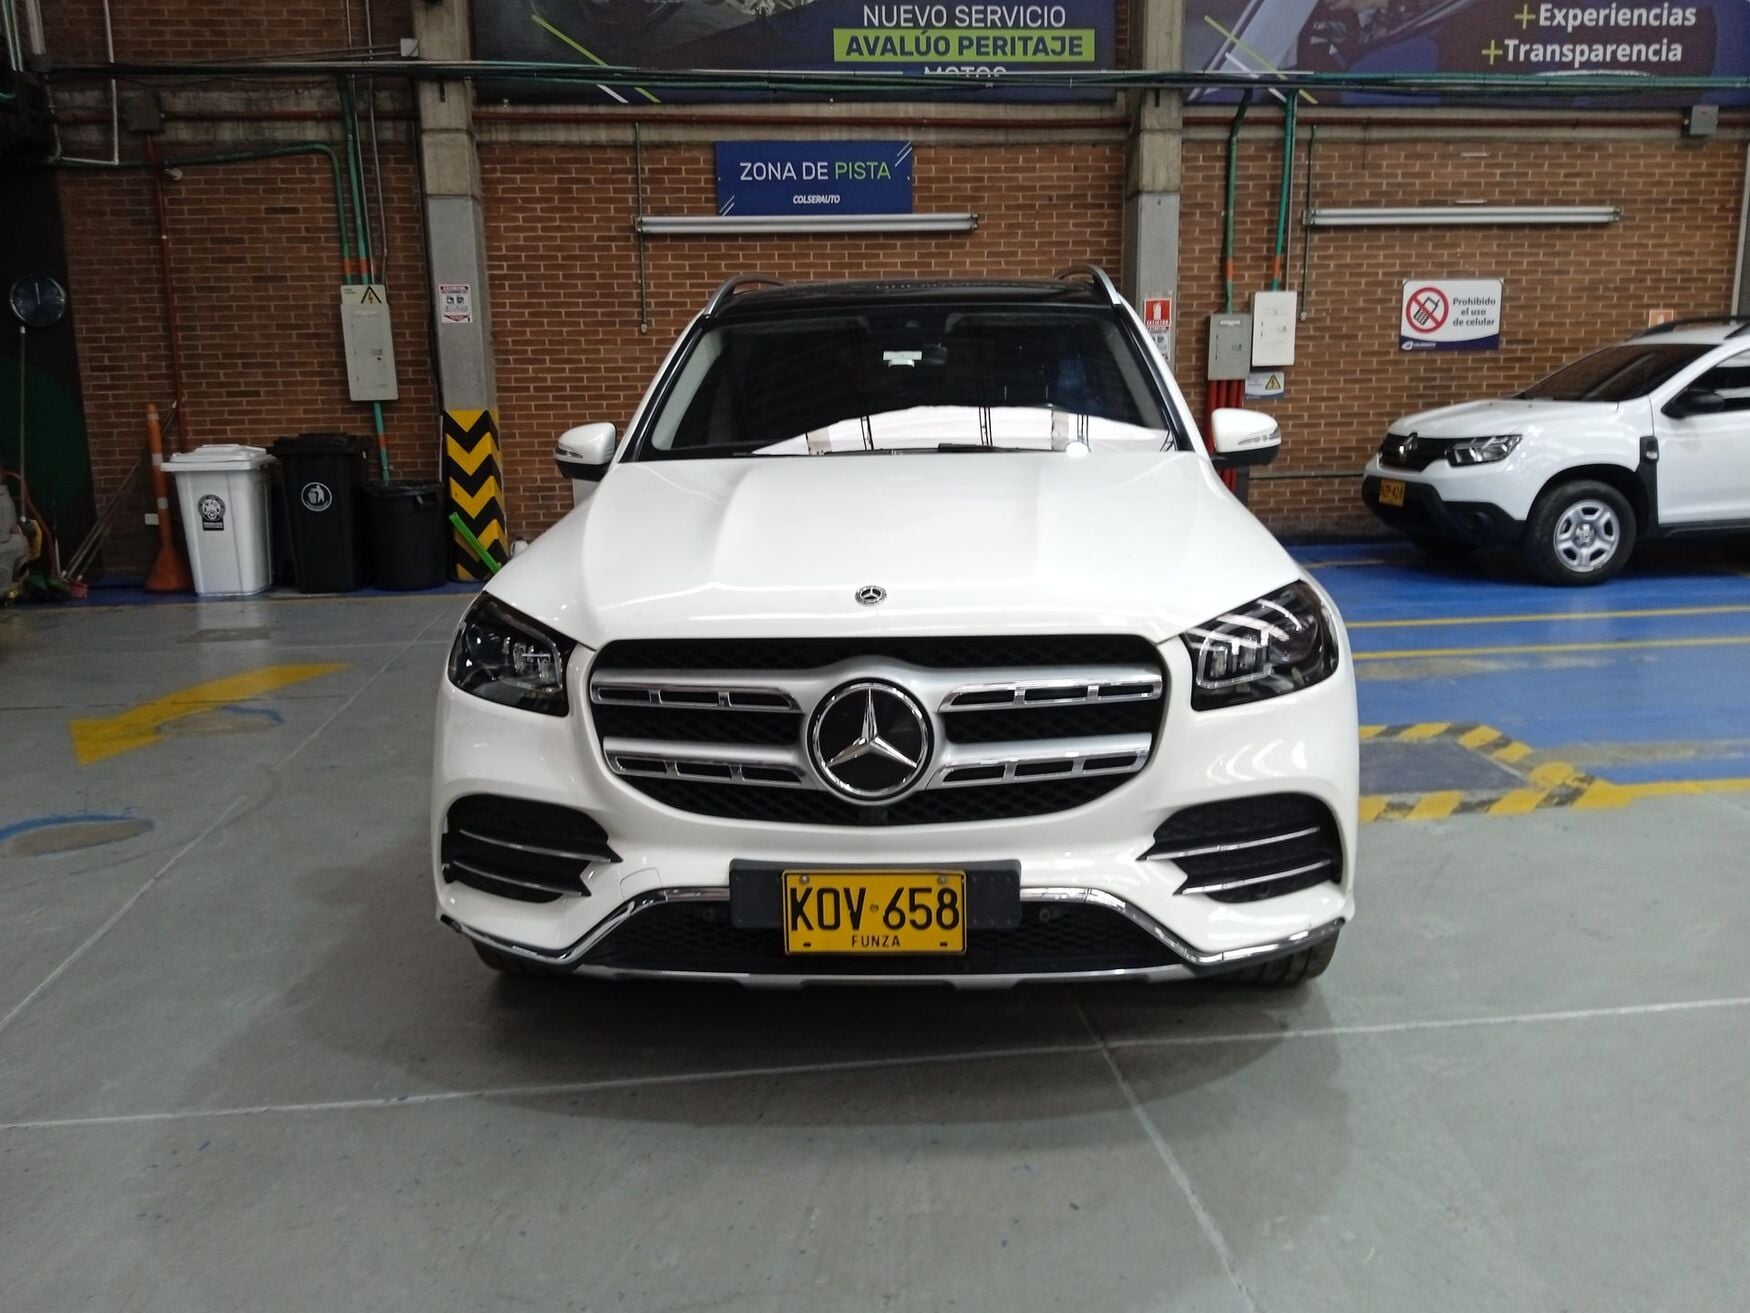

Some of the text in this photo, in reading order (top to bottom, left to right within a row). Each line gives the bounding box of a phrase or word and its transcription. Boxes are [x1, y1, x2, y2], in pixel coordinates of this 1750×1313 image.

[863, 5, 1066, 27] NUEVO SERVICIO
[1514, 3, 1697, 33] +Experiencias
[845, 30, 1083, 56] AVALÚO PERITAJE
[1481, 38, 1683, 68] +Transparencia
[739, 162, 891, 181] ZONA DE PISTA
[1453, 297, 1496, 306] Prohibido
[1461, 307, 1487, 316] el uso
[1453, 318, 1495, 327] de celular
[790, 887, 960, 932] KOV 658
[851, 935, 901, 948] FUNZA
